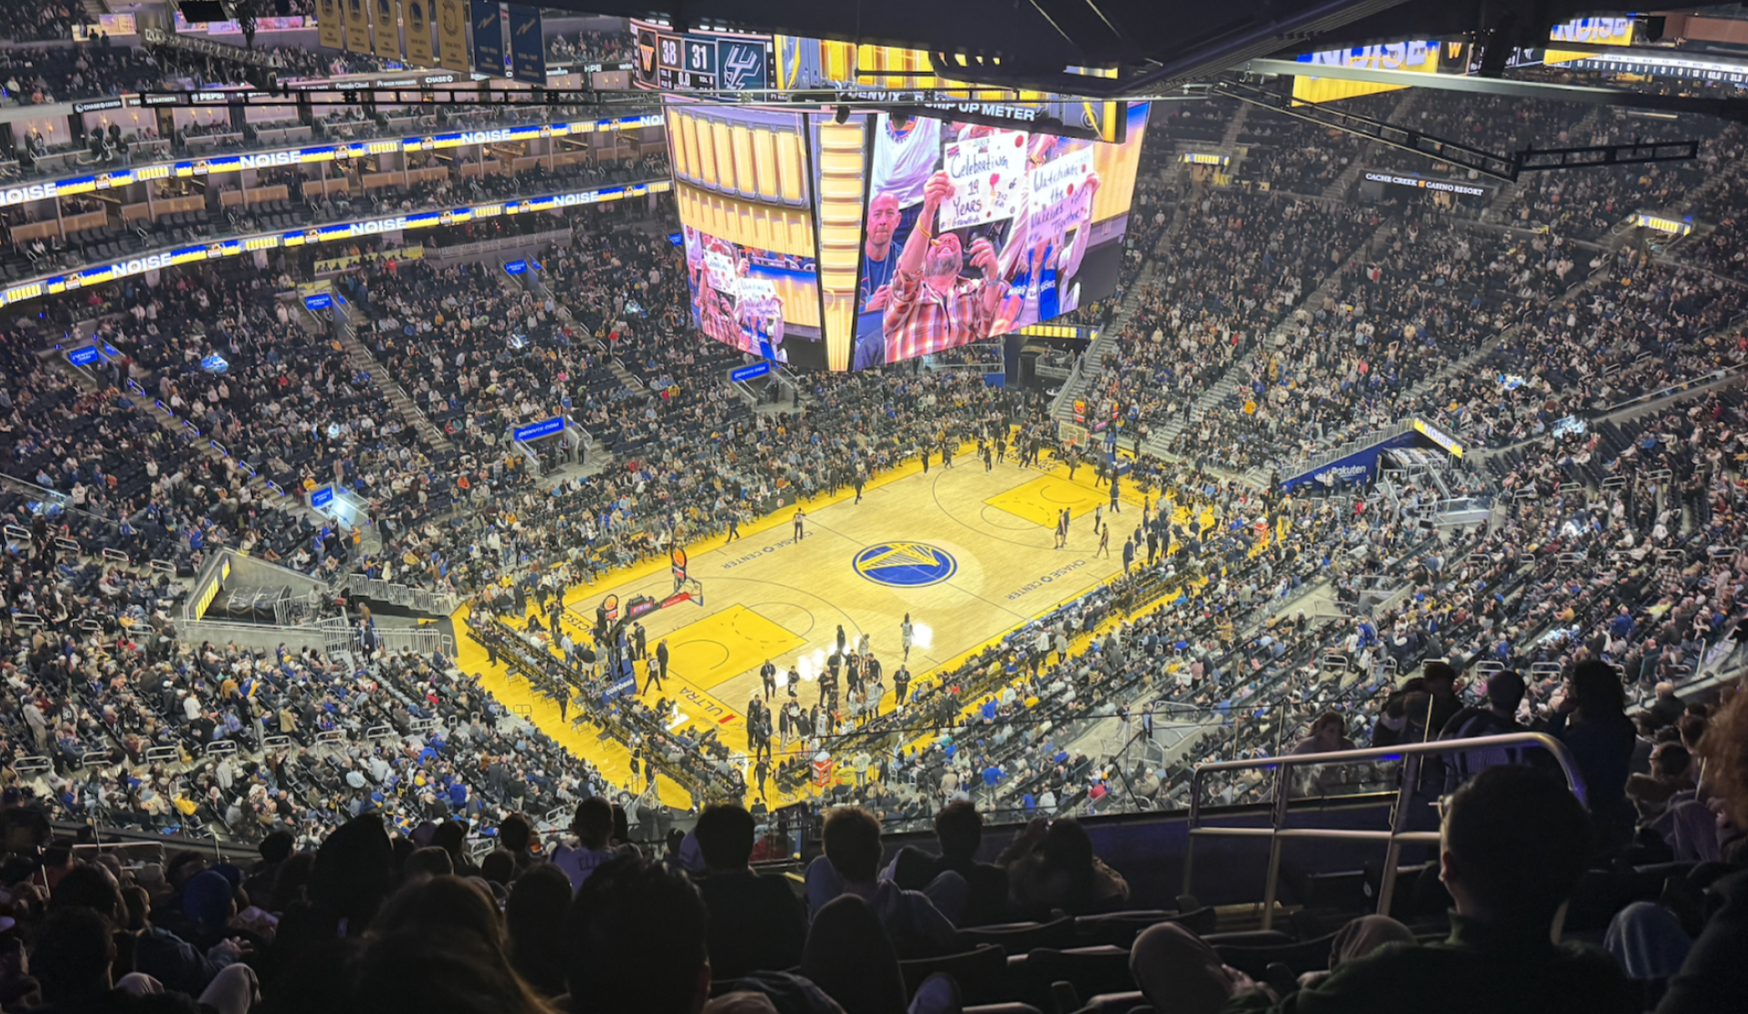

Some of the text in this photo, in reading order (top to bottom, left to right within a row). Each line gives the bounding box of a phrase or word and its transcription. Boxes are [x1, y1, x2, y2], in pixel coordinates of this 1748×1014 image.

[662, 41, 677, 65] 38
[692, 44, 707, 70] 31
[425, 76, 447, 84] CHASE
[200, 92, 225, 101] PEPSI
[958, 101, 979, 113] UP
[981, 103, 1035, 121] METER
[461, 129, 510, 145] NOISE
[240, 150, 301, 170] NOISE
[1365, 173, 1484, 196] CACHE CREEK CASINO RESORT
[553, 191, 599, 208] NOISE
[350, 216, 408, 236] NOISE
[111, 252, 173, 278] NOISE
[1424, 424, 1453, 447] NOISE
[1331, 464, 1367, 476] Rakuten
[1005, 559, 1086, 600] CHASE CENTER
[605, 678, 635, 696] coinbase
[680, 686, 723, 717] ULTRA
